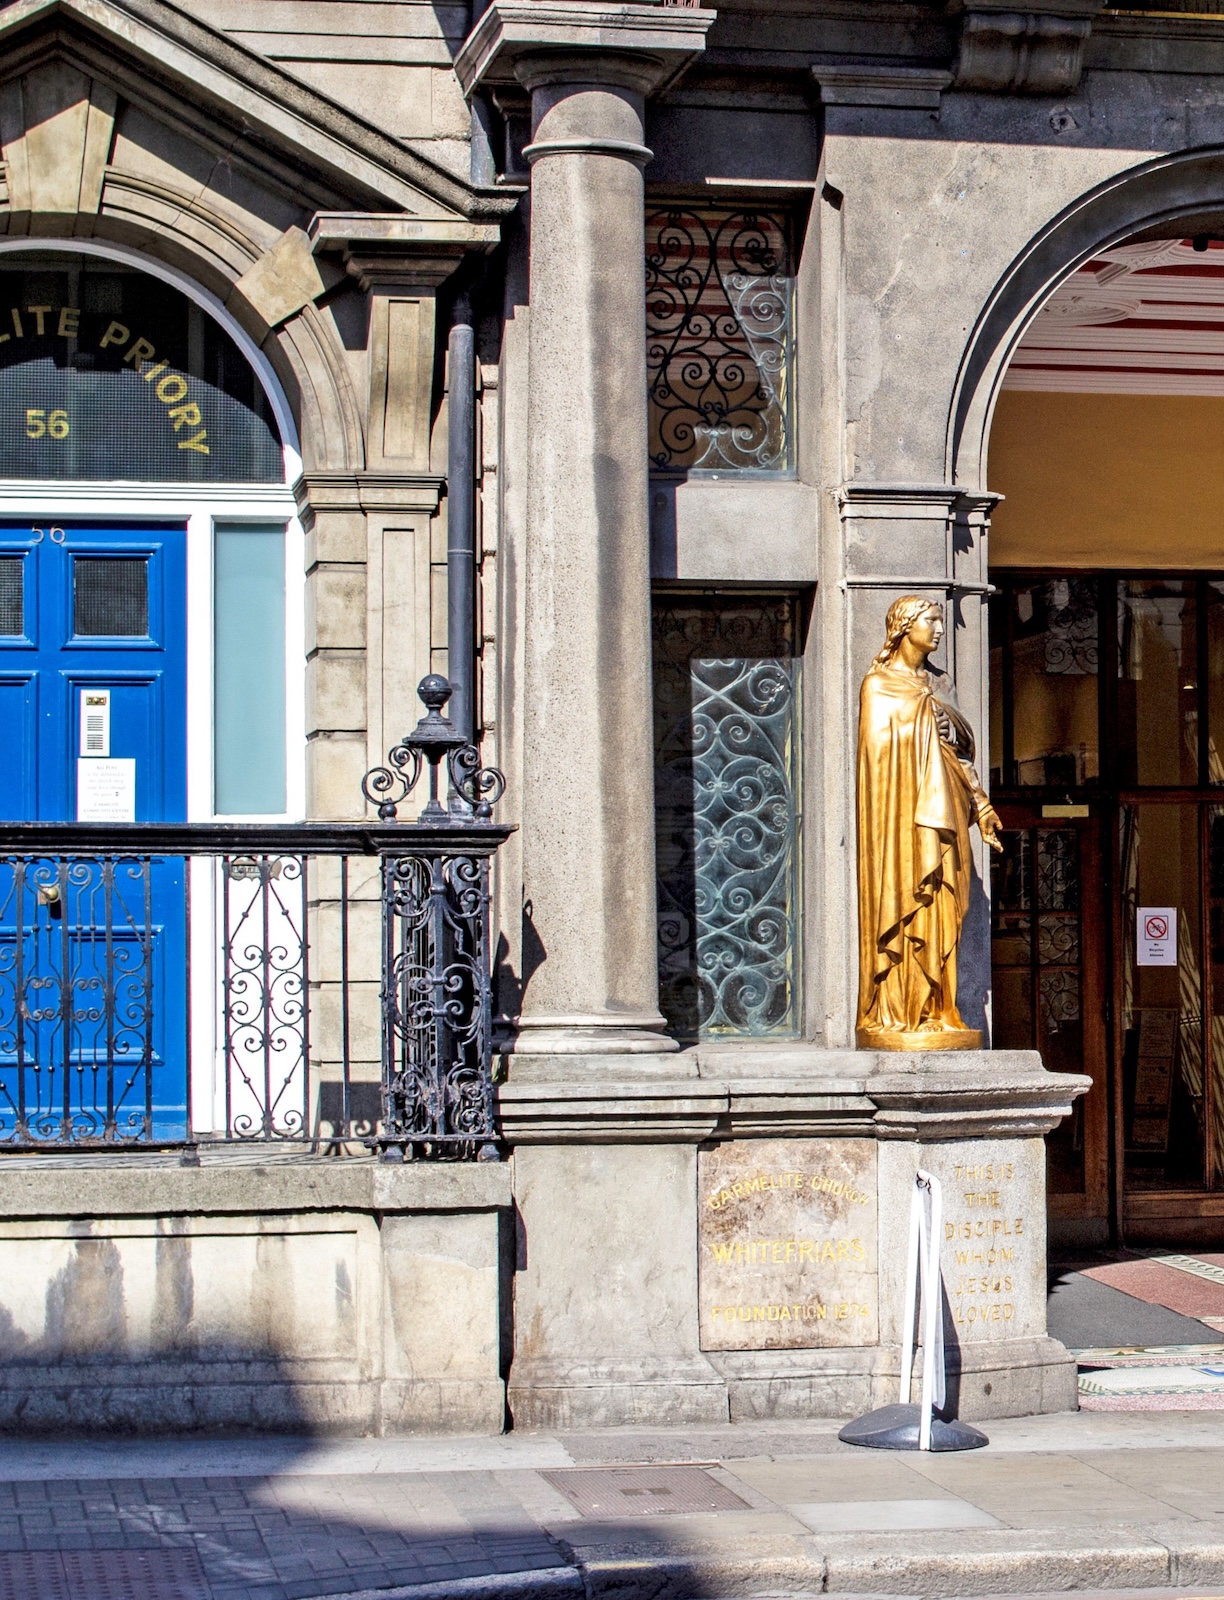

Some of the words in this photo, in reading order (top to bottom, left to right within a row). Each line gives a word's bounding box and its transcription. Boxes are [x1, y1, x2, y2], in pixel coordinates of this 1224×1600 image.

[100, 320, 210, 455] PRIORY
[26, 409, 70, 439] 56
[31, 521, 66, 544] 56
[954, 1164, 994, 1182] THIS
[1000, 1162, 1015, 1181] IS
[706, 1172, 804, 1209] CARMELITE
[810, 1174, 871, 1207] CHURCH
[963, 1191, 1002, 1208] THE
[945, 1217, 1024, 1241] DISCIPLE
[711, 1237, 866, 1266] WHITEFRIARS
[954, 1247, 1015, 1265] WHOM
[955, 1274, 1014, 1296] JESUS
[710, 1304, 827, 1324] FOUNDATION
[834, 1301, 870, 1320] 1274
[955, 1303, 1016, 1324] LOVED
